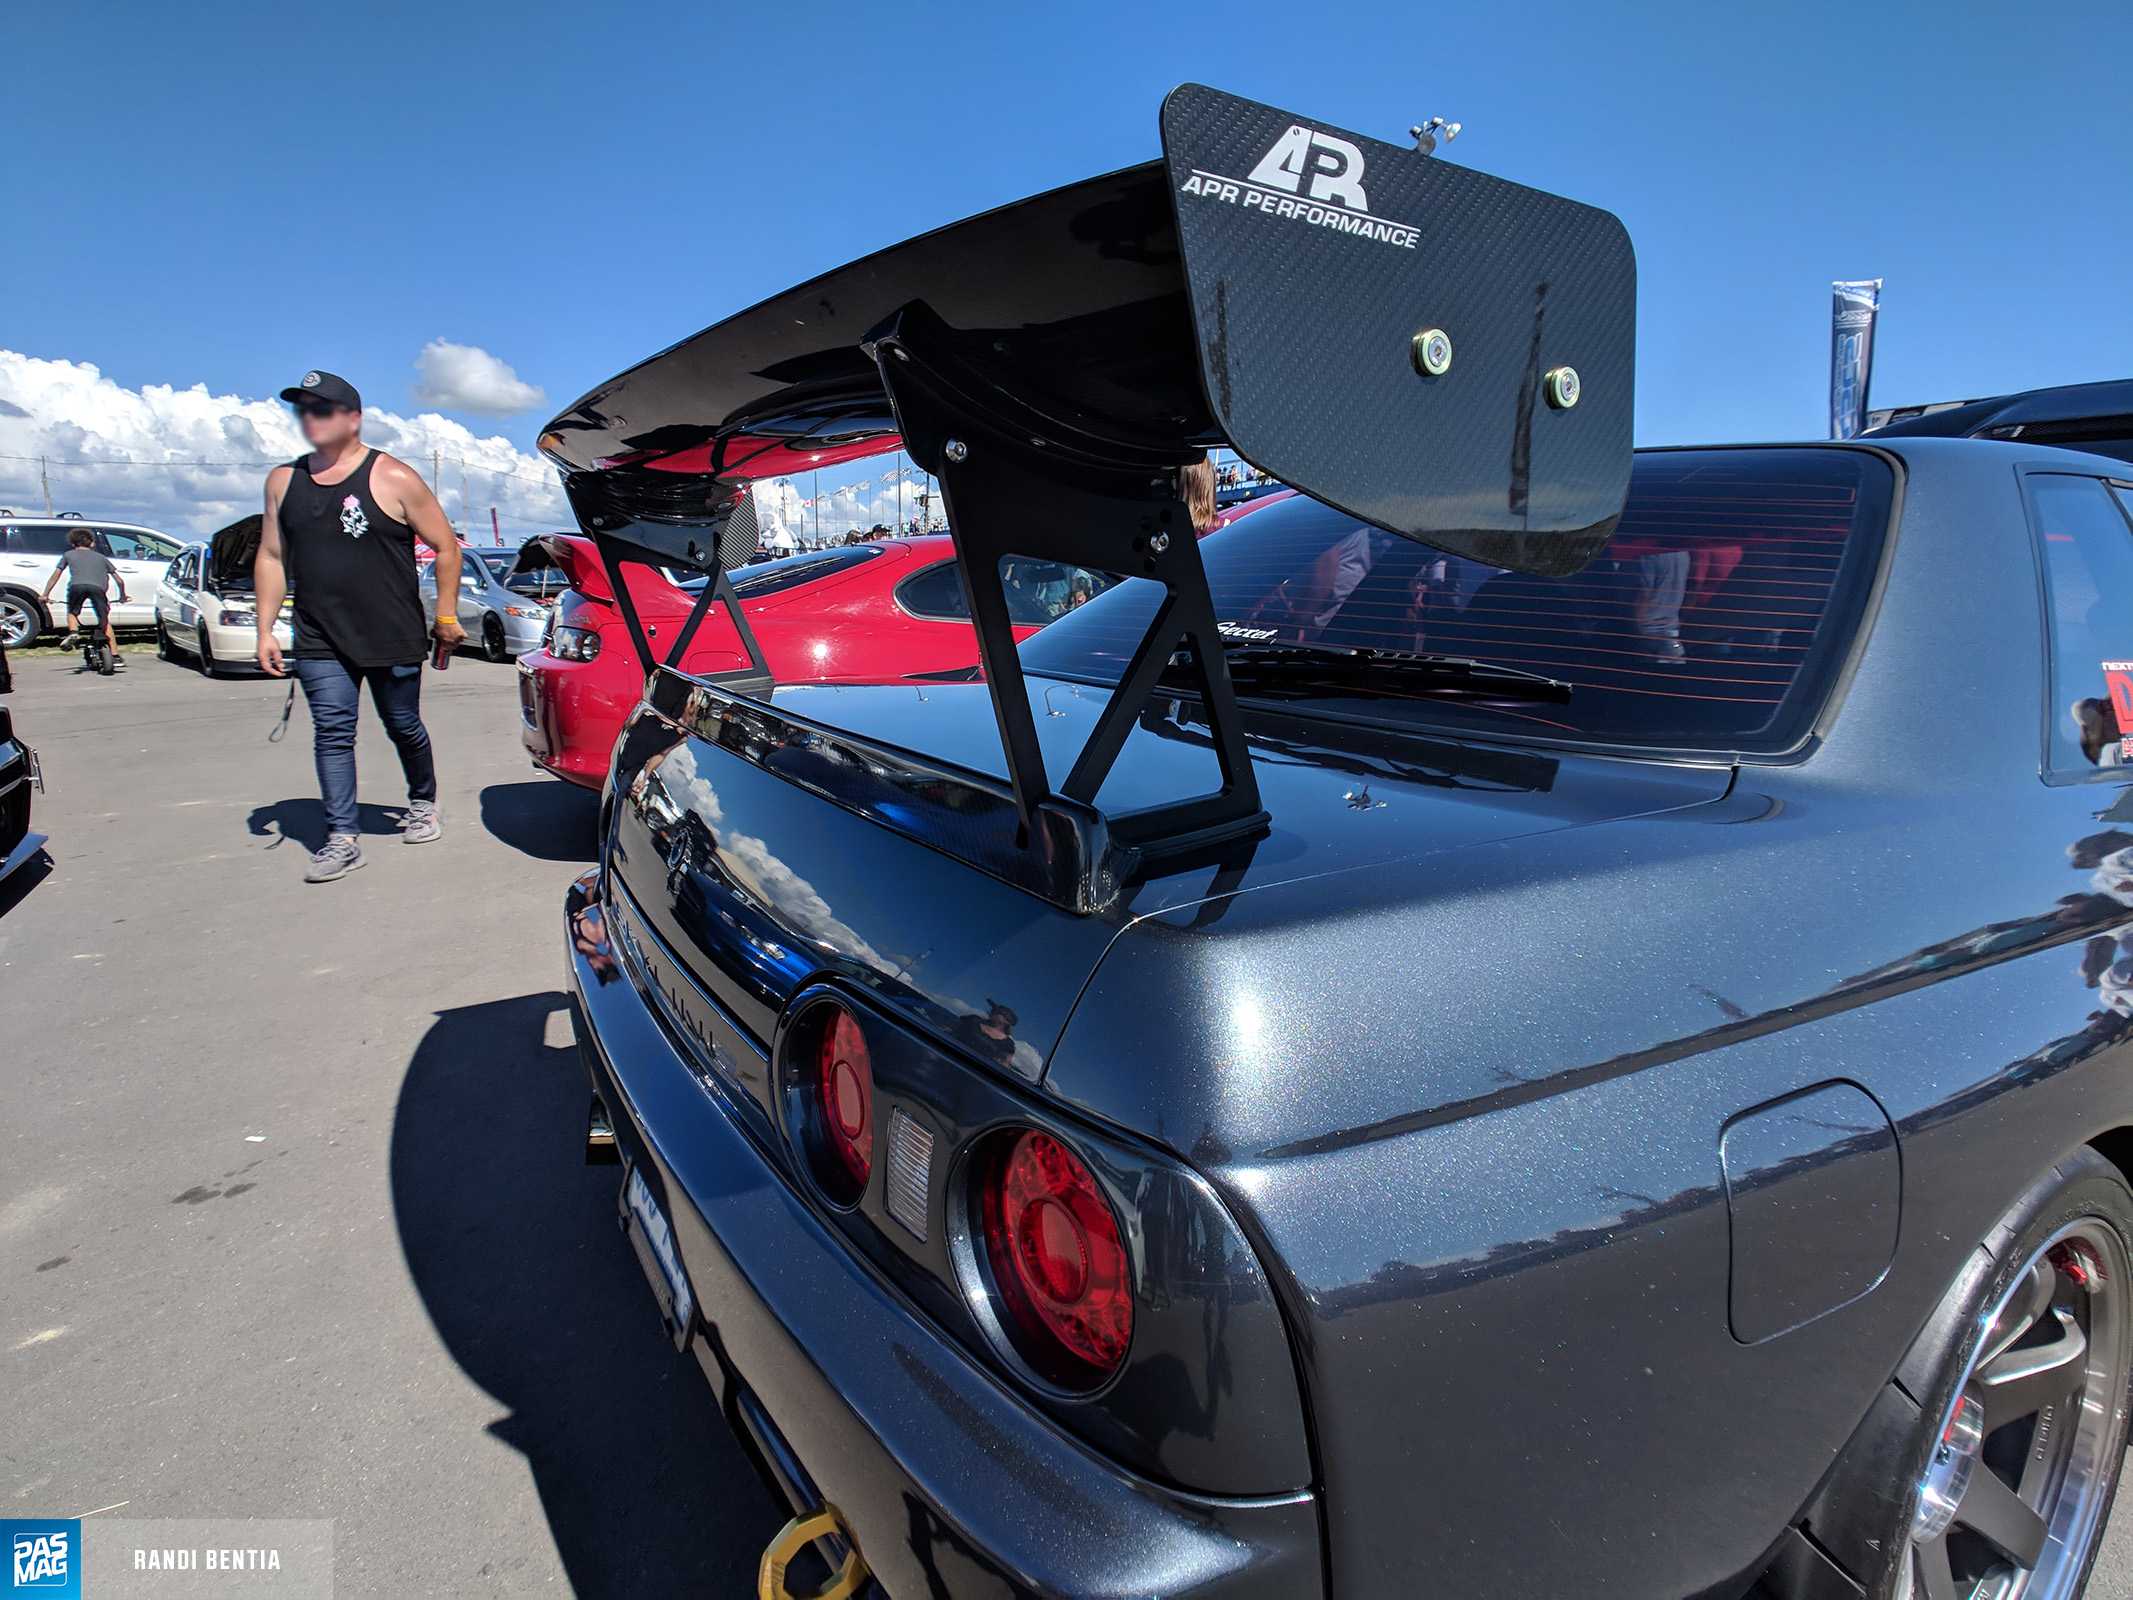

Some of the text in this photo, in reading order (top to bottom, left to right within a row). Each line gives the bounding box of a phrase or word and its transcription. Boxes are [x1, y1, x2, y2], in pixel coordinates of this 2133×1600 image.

[1181, 175, 1420, 249] APR PERFORMANCE
[1217, 621, 1279, 640] Secret
